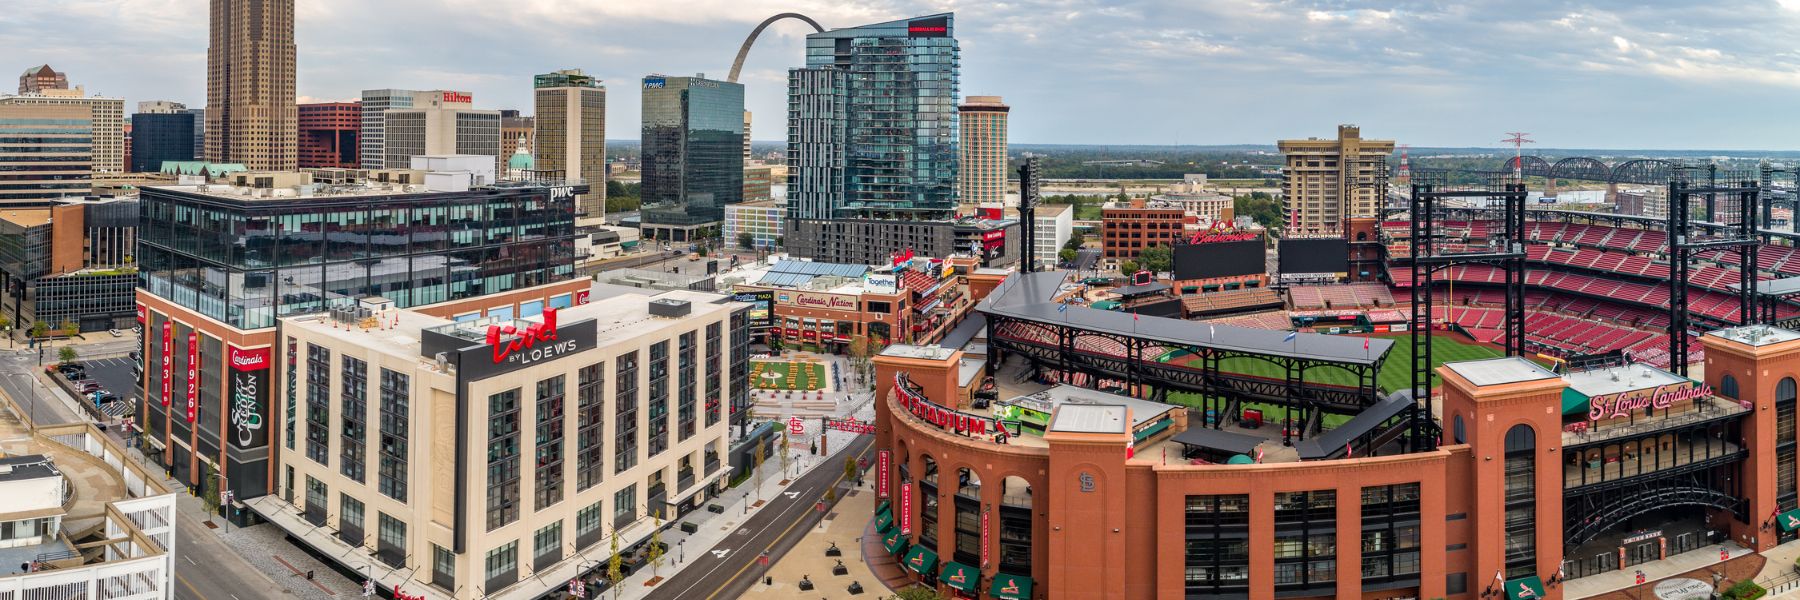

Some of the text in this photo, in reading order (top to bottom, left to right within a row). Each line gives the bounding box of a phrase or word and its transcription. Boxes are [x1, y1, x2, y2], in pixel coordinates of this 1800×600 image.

[443, 91, 472, 104] Hilton
[550, 186, 574, 202] pwc
[1190, 231, 1258, 245] Budweiser
[868, 276, 895, 287] Together
[796, 294, 827, 306] Cardinals
[826, 295, 853, 308] Nation
[232, 349, 263, 366] Cardinals
[509, 339, 577, 365] BY LOEWS
[247, 373, 262, 430] UNION
[1589, 382, 1713, 420] St. Louis Cardinals
[238, 380, 252, 447] CREDIT
